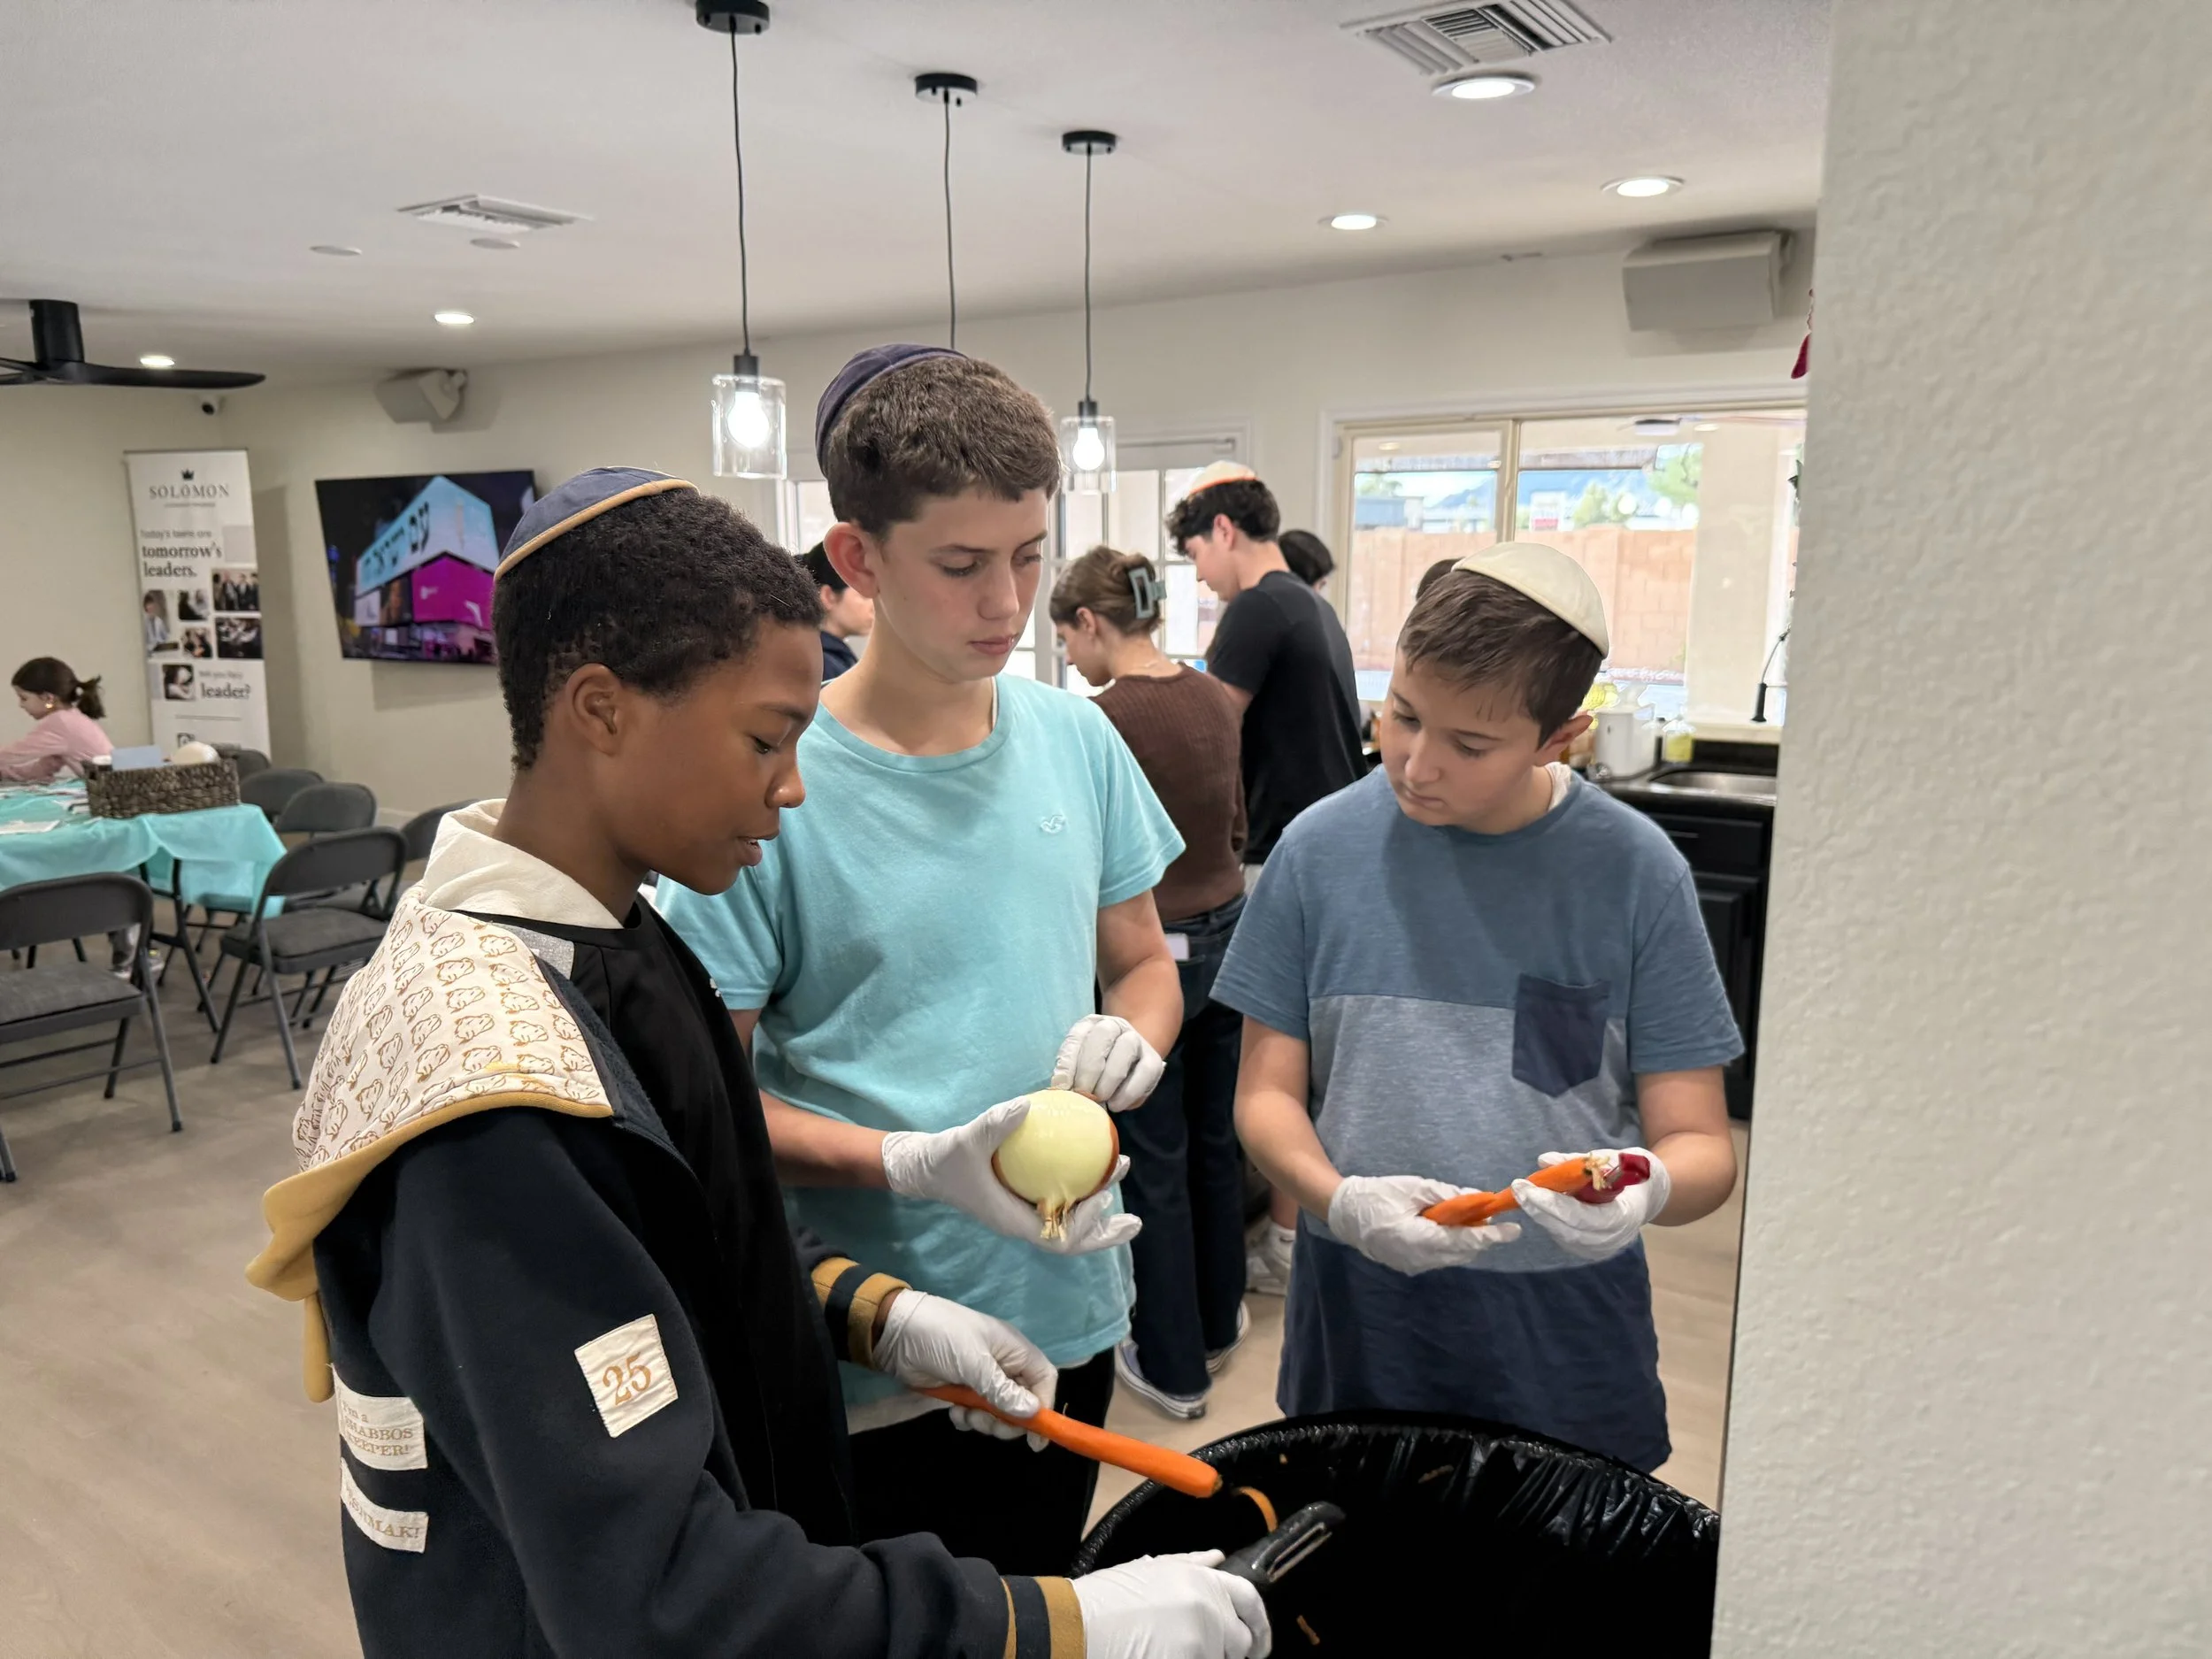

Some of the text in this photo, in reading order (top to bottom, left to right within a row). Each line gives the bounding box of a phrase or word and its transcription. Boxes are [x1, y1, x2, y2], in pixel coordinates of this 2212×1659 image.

[149, 485, 228, 499] SOLOMON
[142, 541, 222, 558] tomorrow's
[143, 560, 197, 578] leaders.
[200, 681, 251, 699] leader?
[603, 1351, 651, 1405] 25
